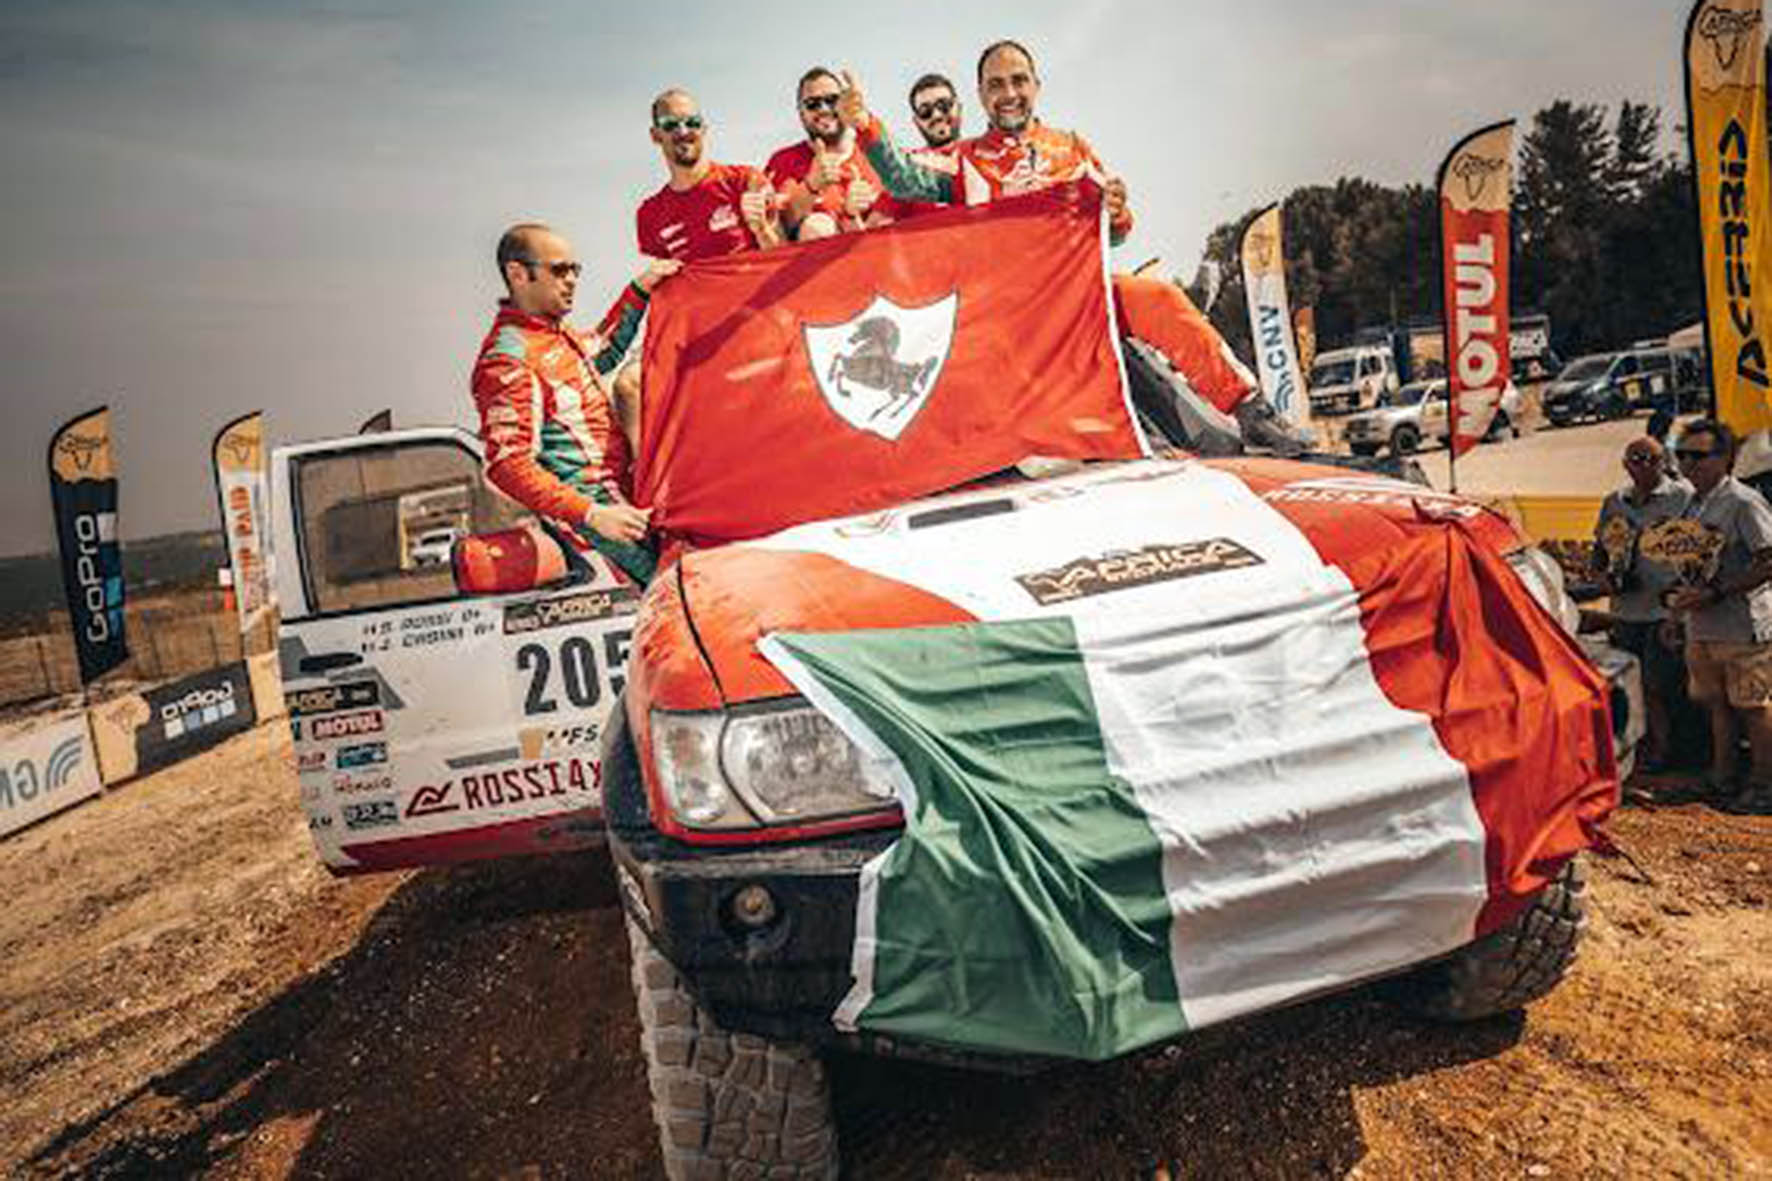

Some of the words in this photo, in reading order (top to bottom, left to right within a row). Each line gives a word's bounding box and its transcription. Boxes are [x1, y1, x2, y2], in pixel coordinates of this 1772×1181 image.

[1452, 233, 1500, 438] MOTUL
[74, 514, 110, 642] GoPro
[316, 713, 379, 738] MOTUL
[517, 630, 632, 715] 205
